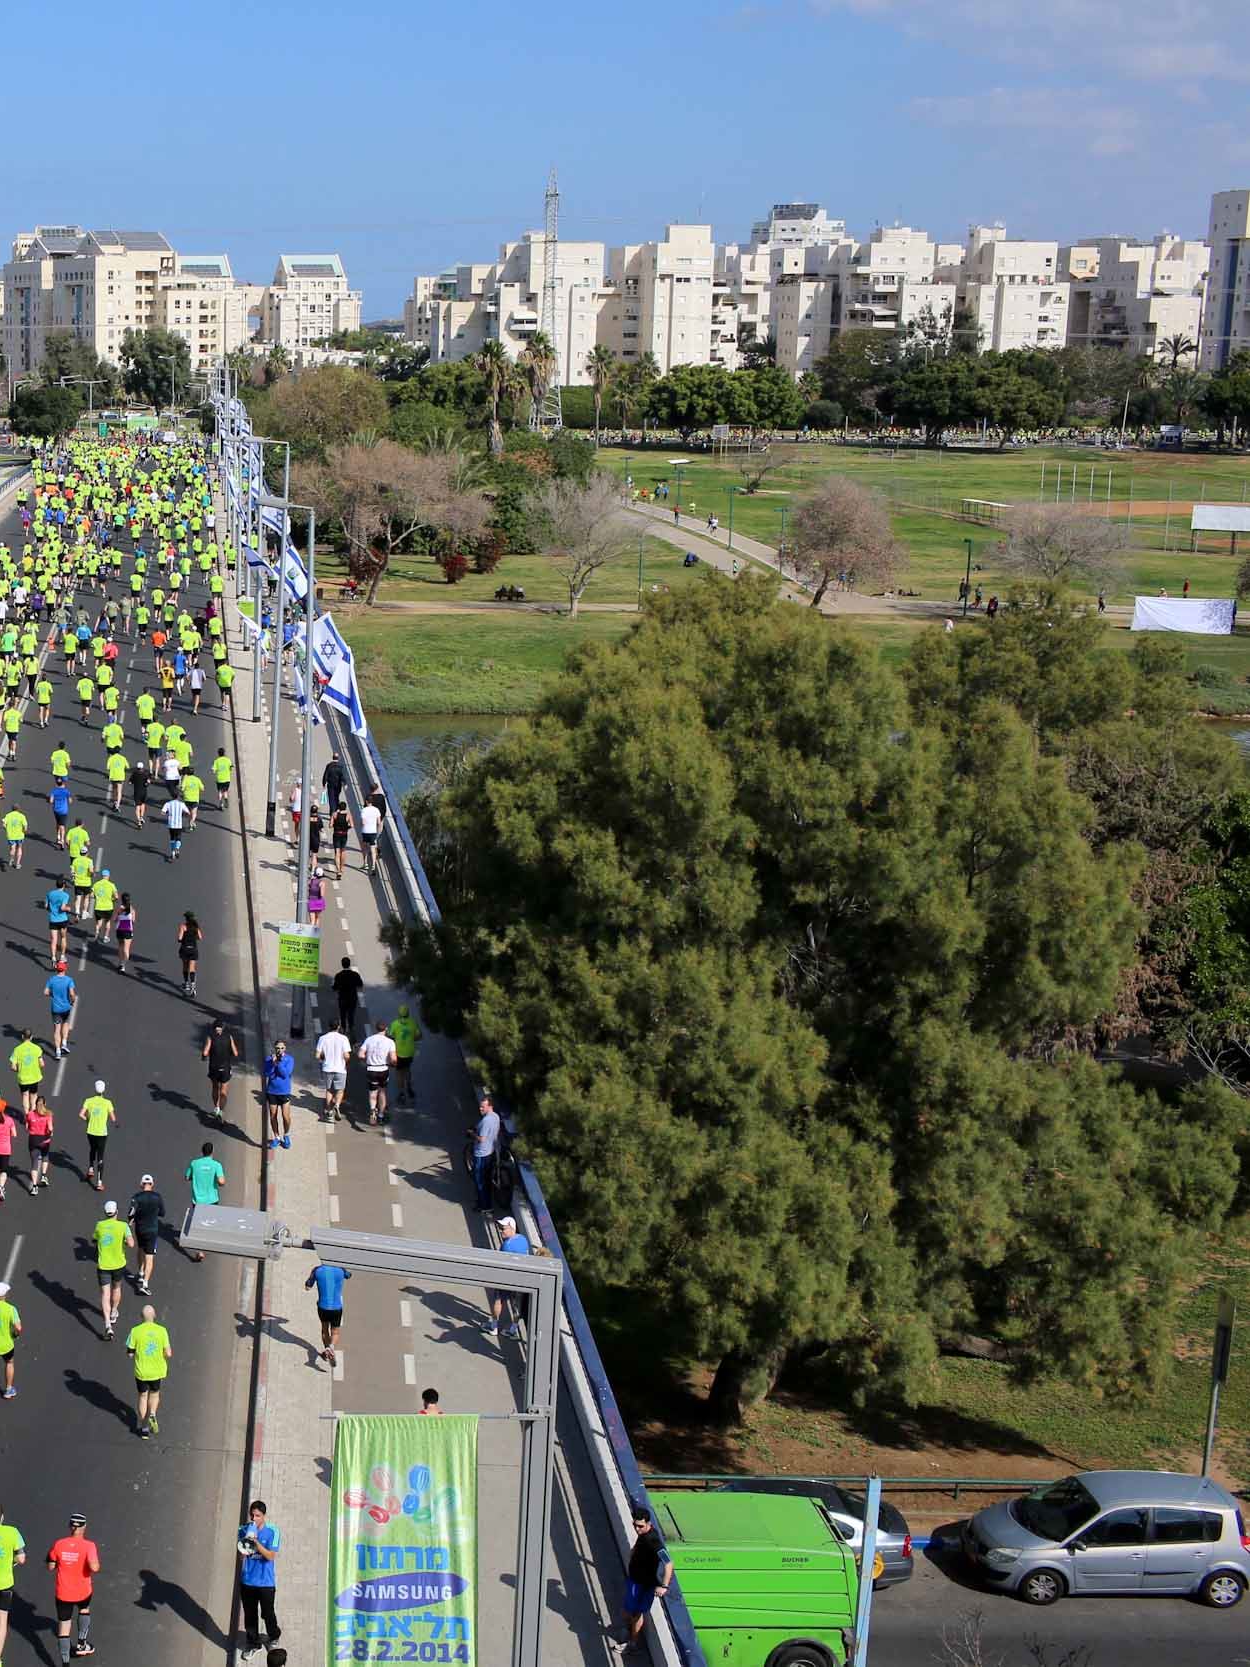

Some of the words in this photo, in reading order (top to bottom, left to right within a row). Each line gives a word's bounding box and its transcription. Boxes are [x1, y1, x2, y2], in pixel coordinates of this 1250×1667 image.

[356, 1544, 448, 1570] מרתון
[352, 1583, 452, 1600] SAMSUNG
[334, 1639, 470, 1665] 28.2.2014
